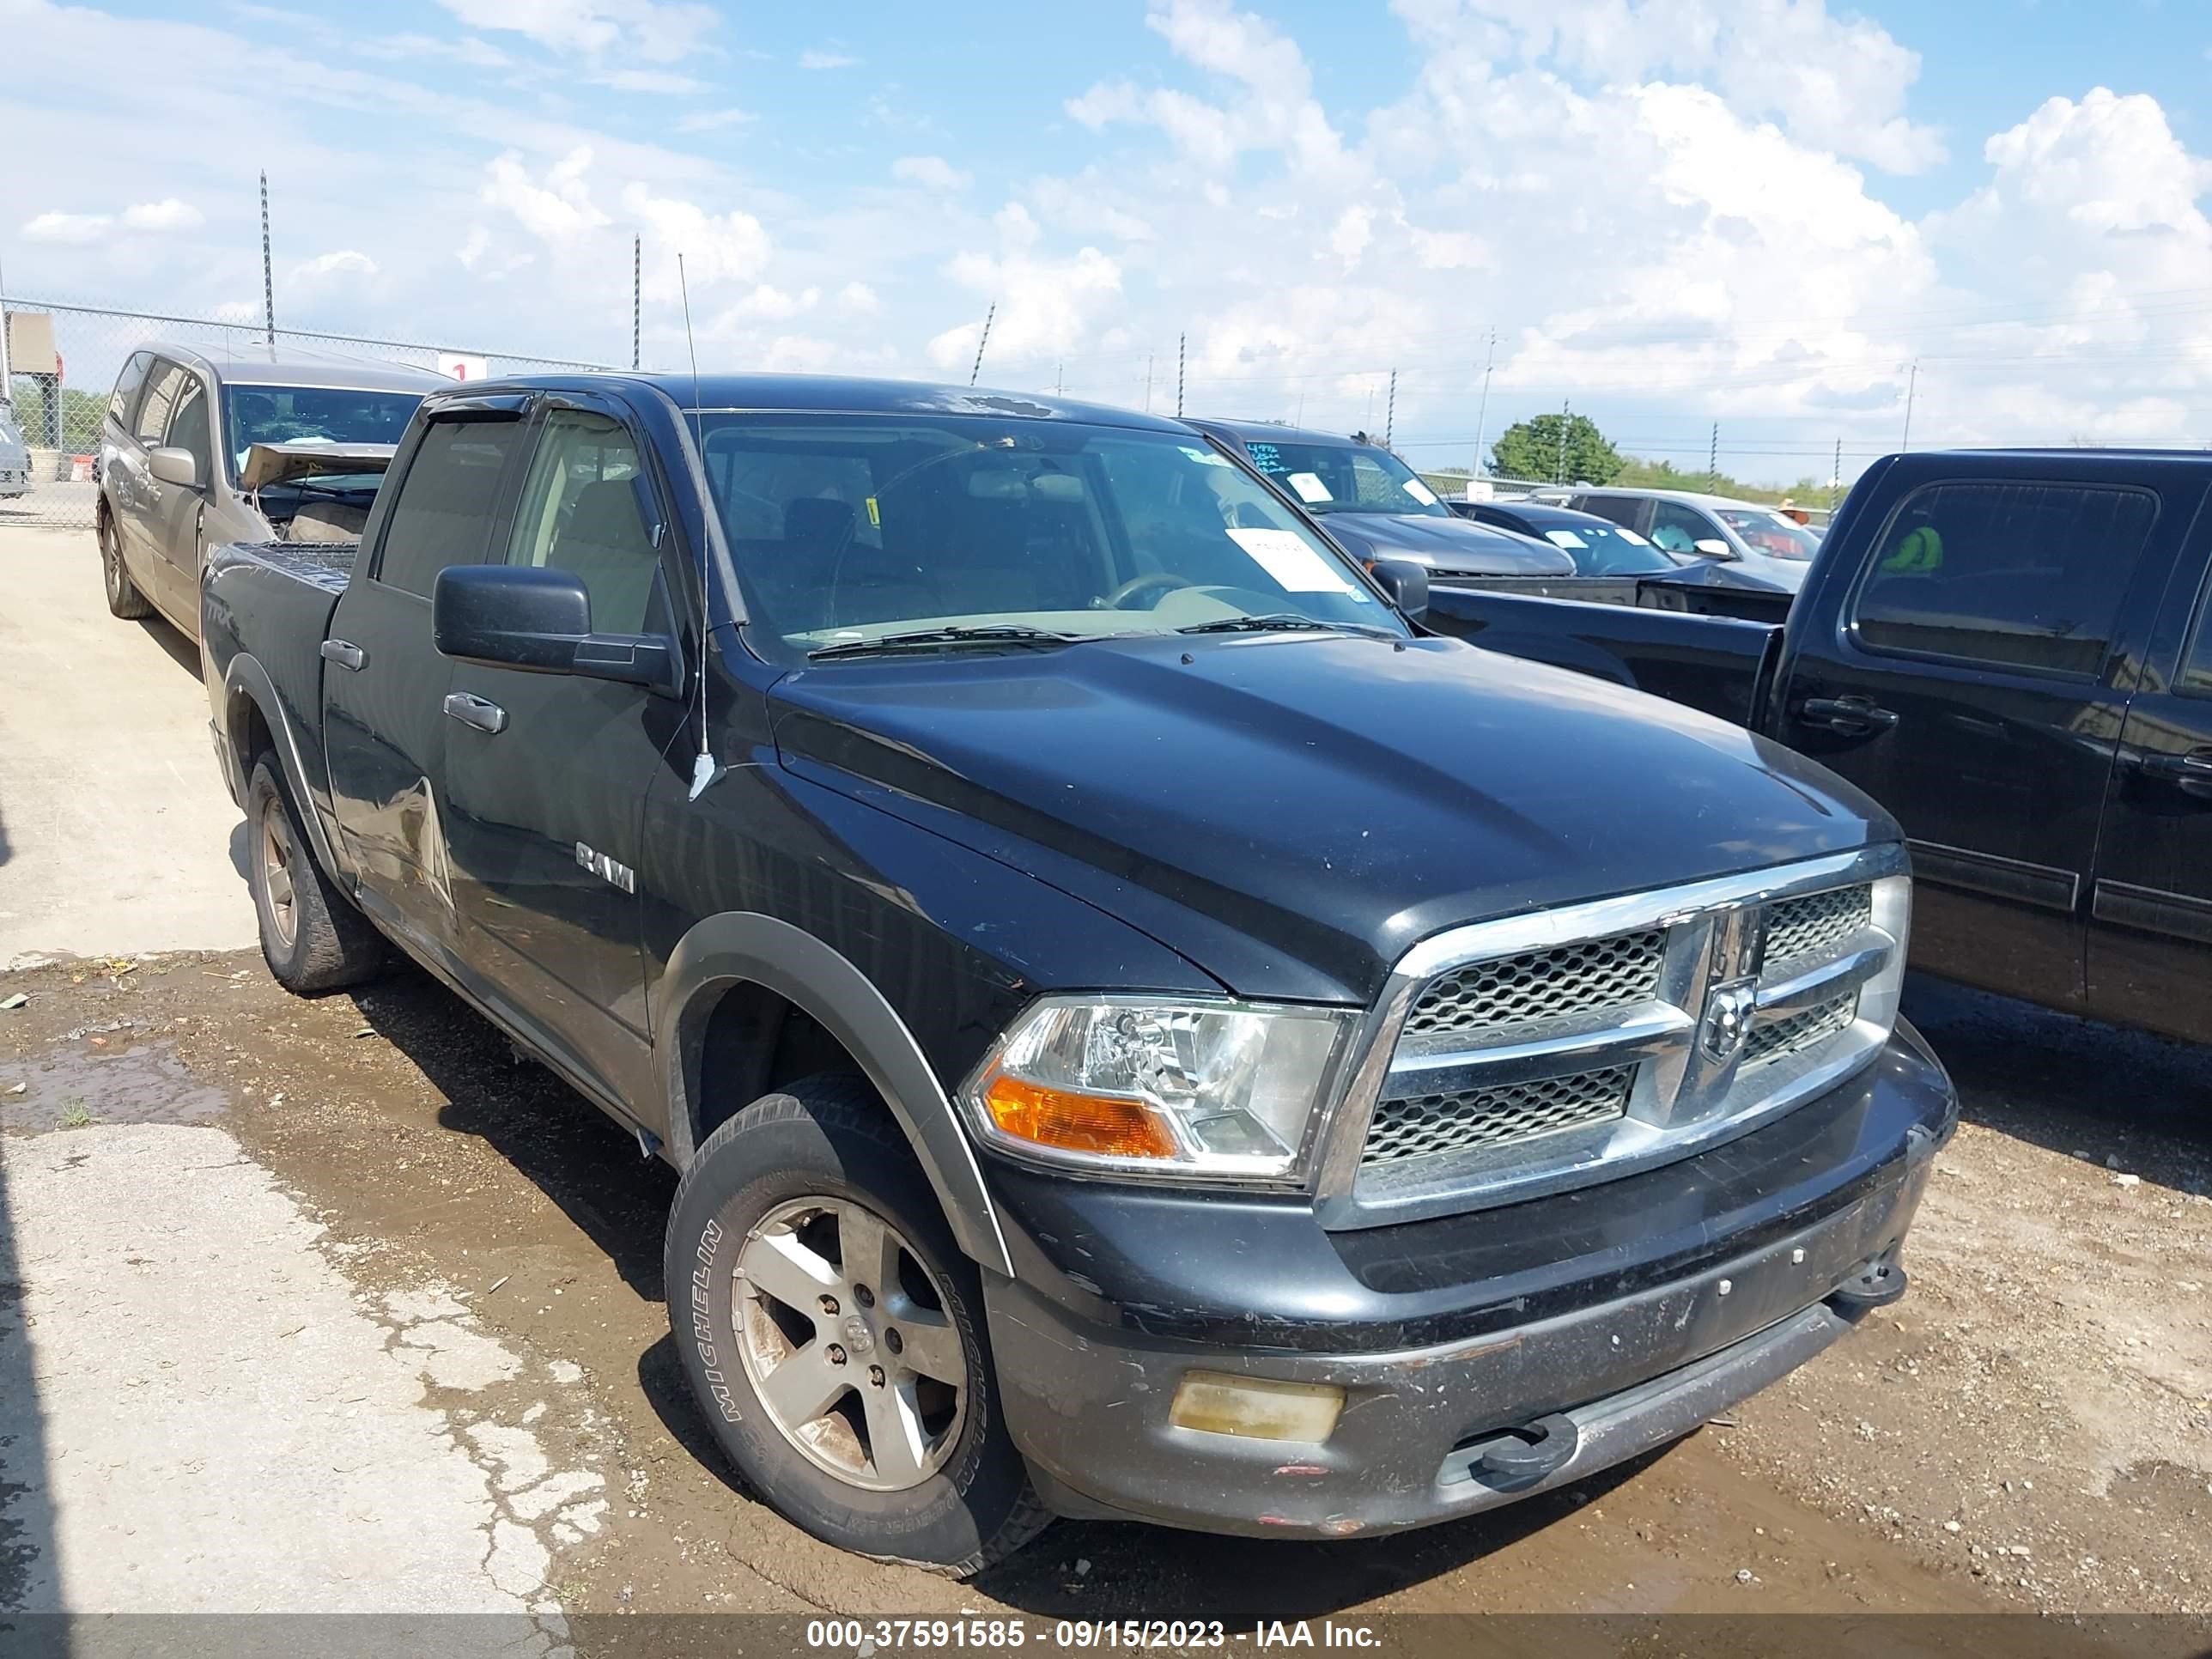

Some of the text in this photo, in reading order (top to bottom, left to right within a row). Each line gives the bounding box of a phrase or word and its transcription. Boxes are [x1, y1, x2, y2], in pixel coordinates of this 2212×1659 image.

[575, 841, 635, 895] RAM
[691, 1218, 743, 1423] MICHELIN
[937, 1273, 988, 1498] MICHELIN
